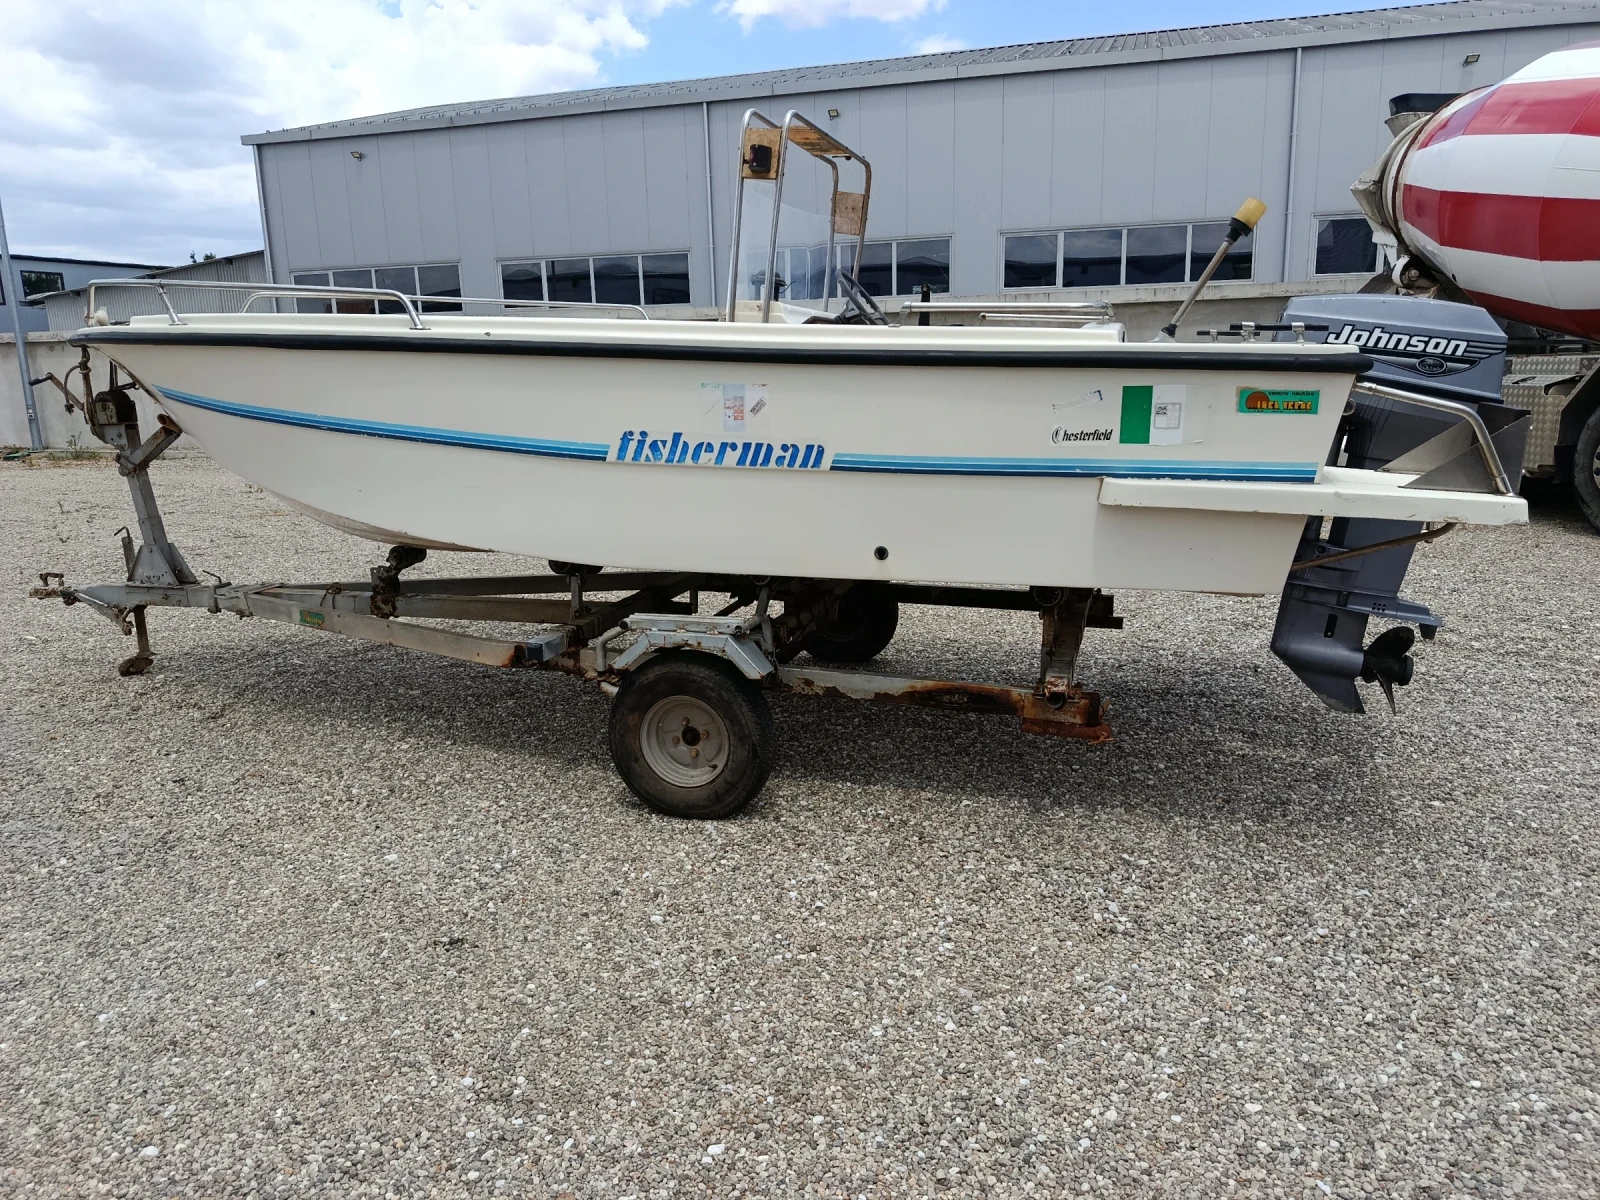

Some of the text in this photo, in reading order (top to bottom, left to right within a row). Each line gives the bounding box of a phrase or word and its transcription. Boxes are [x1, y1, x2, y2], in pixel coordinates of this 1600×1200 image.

[1326, 324, 1468, 356] Johnson
[615, 429, 825, 469] fisherman
[1051, 425, 1113, 444] Chesterfield
